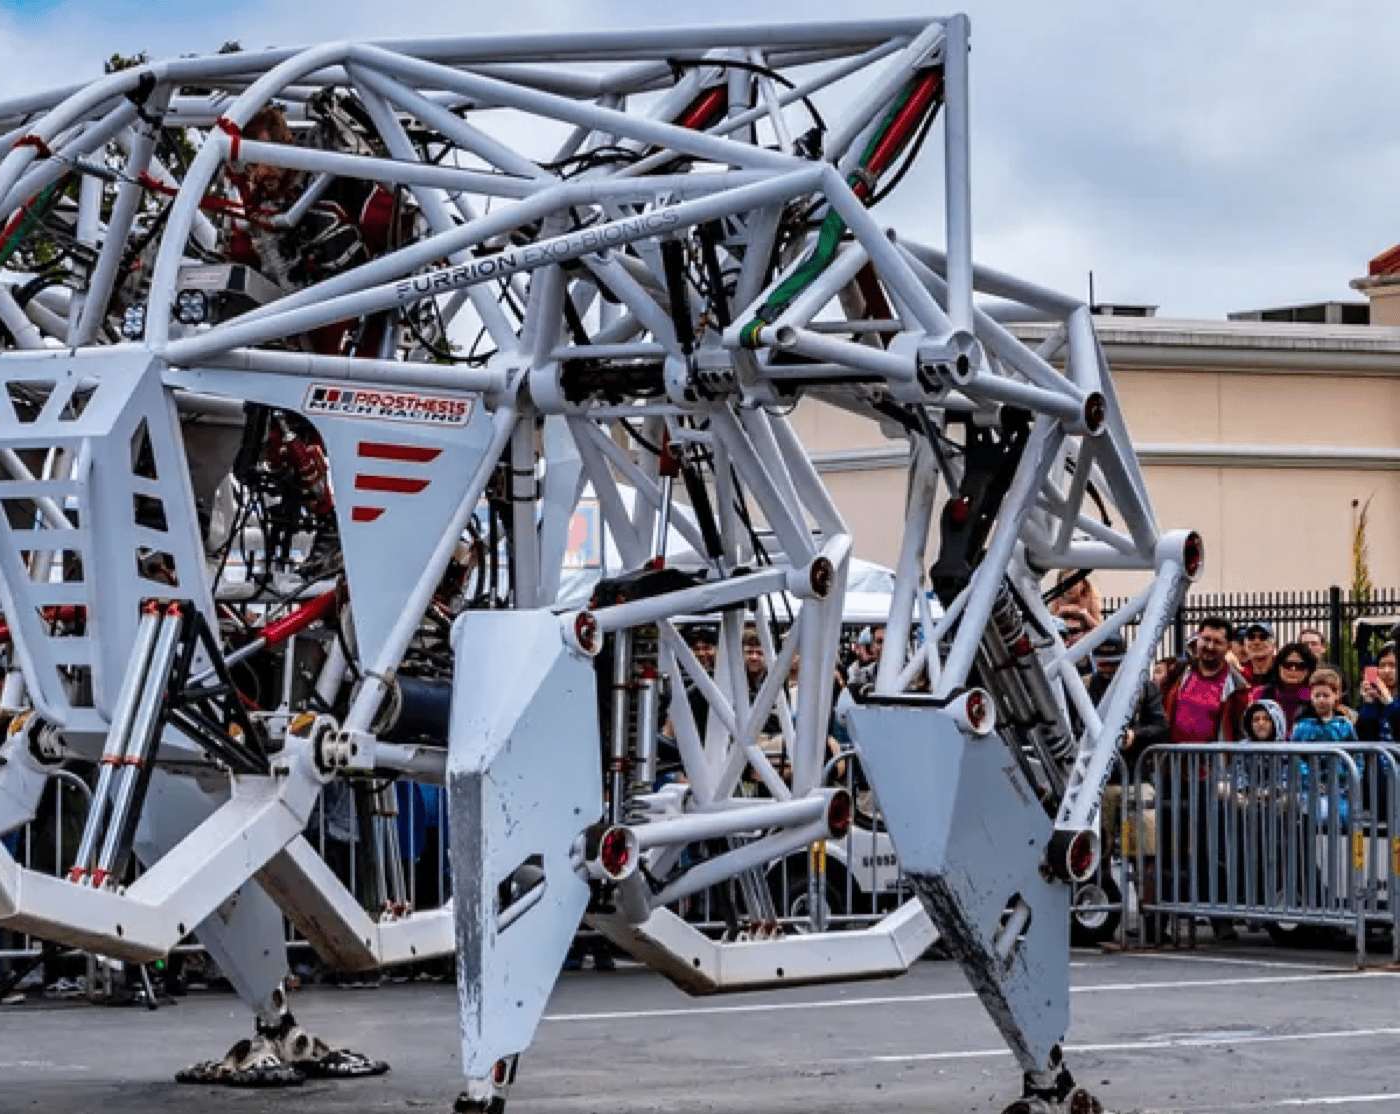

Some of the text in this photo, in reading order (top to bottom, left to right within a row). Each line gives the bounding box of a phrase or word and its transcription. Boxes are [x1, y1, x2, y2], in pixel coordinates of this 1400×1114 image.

[397, 208, 680, 299] FURRION EXO-BIONICS
[355, 392, 467, 416] PROSTHESIS
